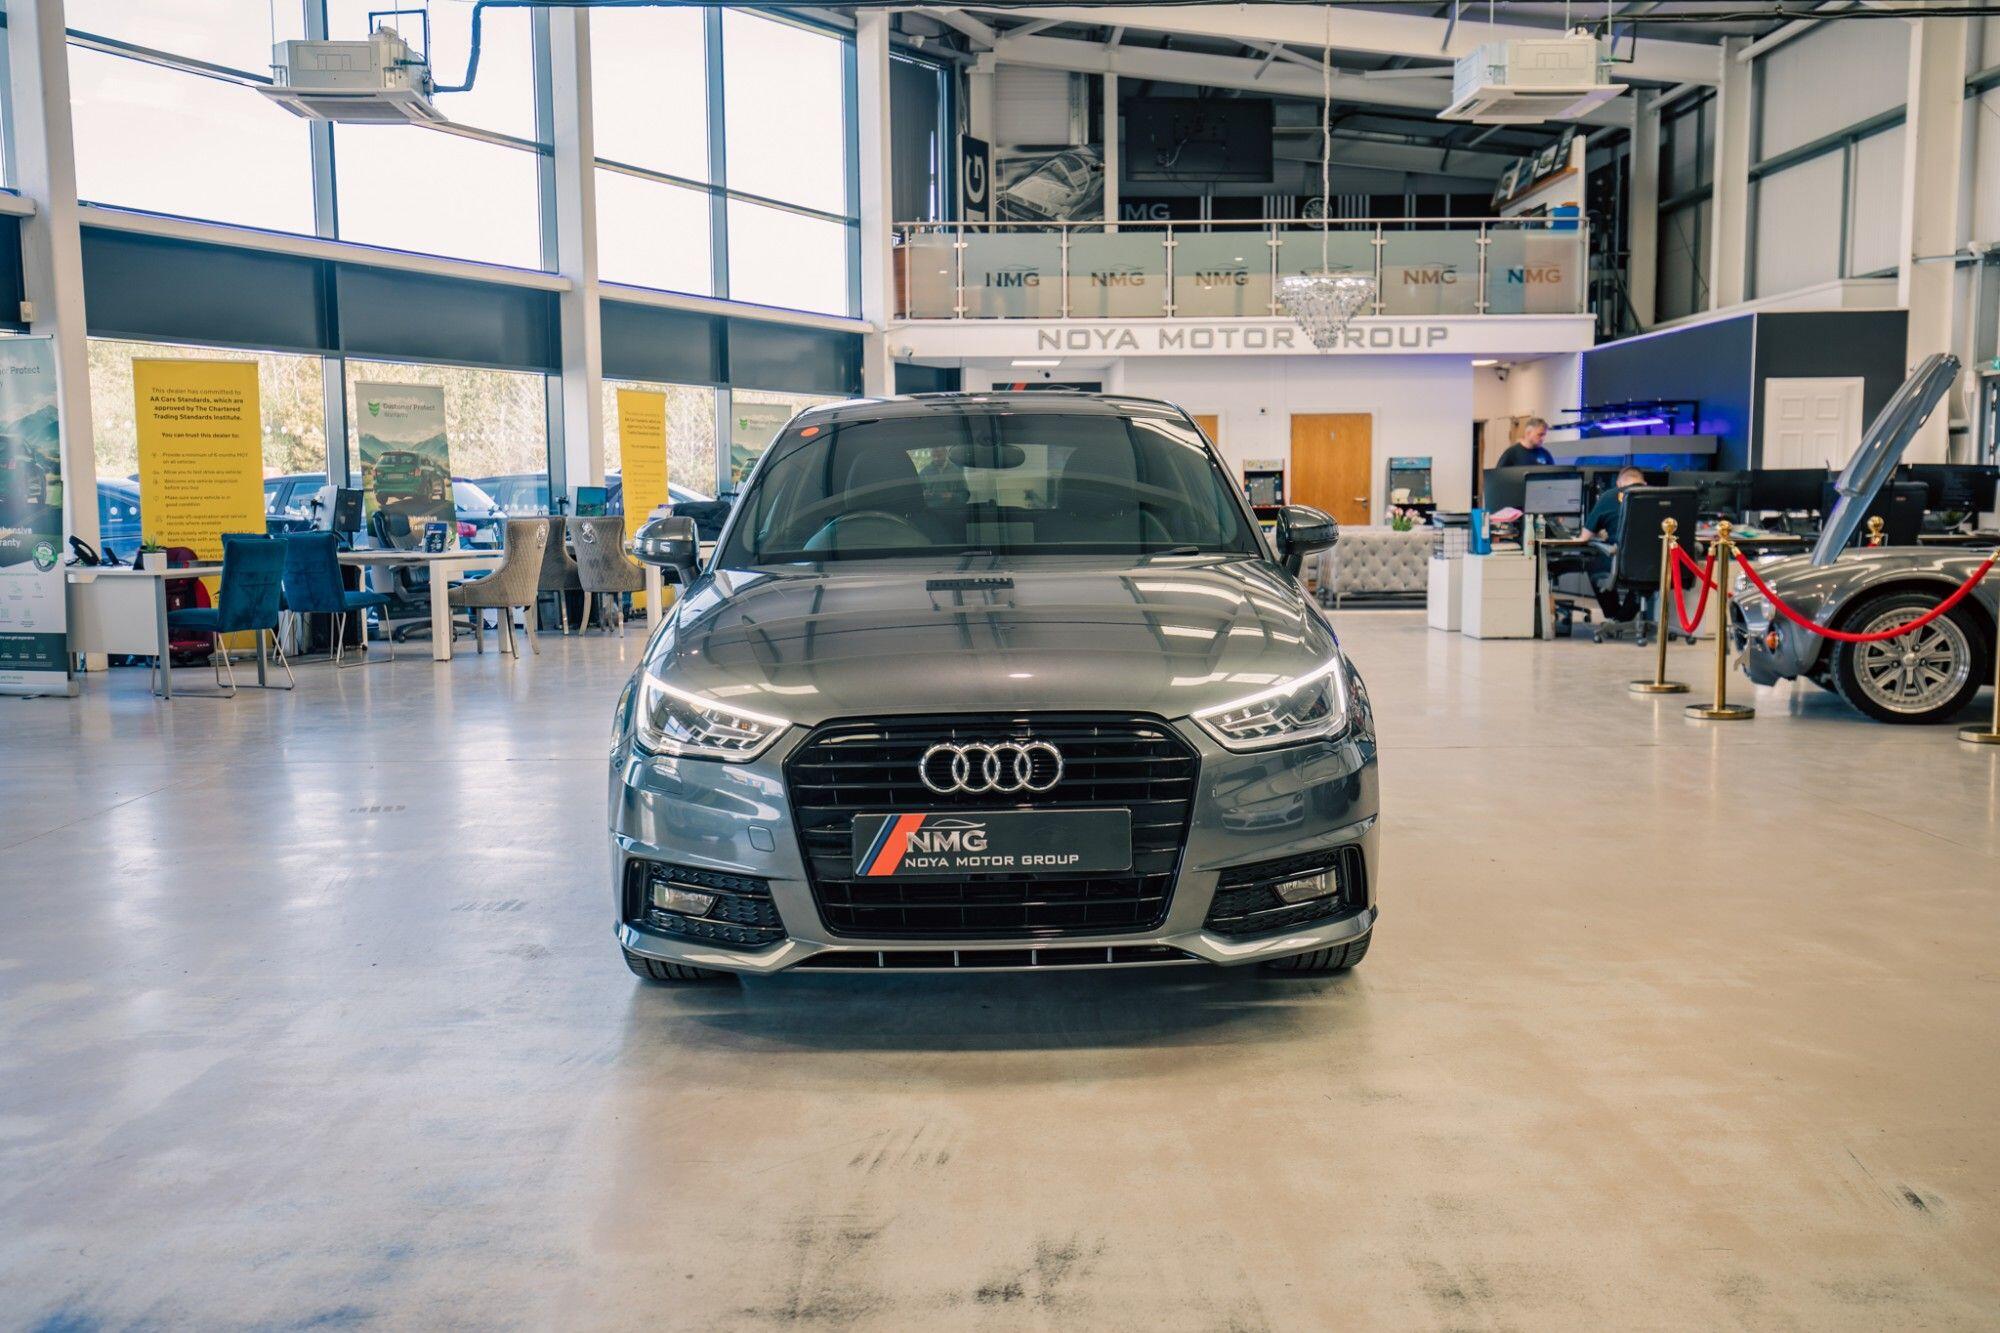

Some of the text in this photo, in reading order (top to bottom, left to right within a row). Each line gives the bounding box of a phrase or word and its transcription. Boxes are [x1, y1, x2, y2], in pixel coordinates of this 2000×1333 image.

[985, 272, 1040, 287] NMG
[1091, 272, 1146, 287] NMG
[1195, 271, 1250, 286] NMG
[1508, 269, 1562, 284] NMG
[1038, 327, 1448, 350] NOYA MOTOR ROUP
[154, 413, 178, 421] Trading
[905, 830, 988, 852] NMG
[905, 854, 1079, 868] NOYA MOTOR GROUP
